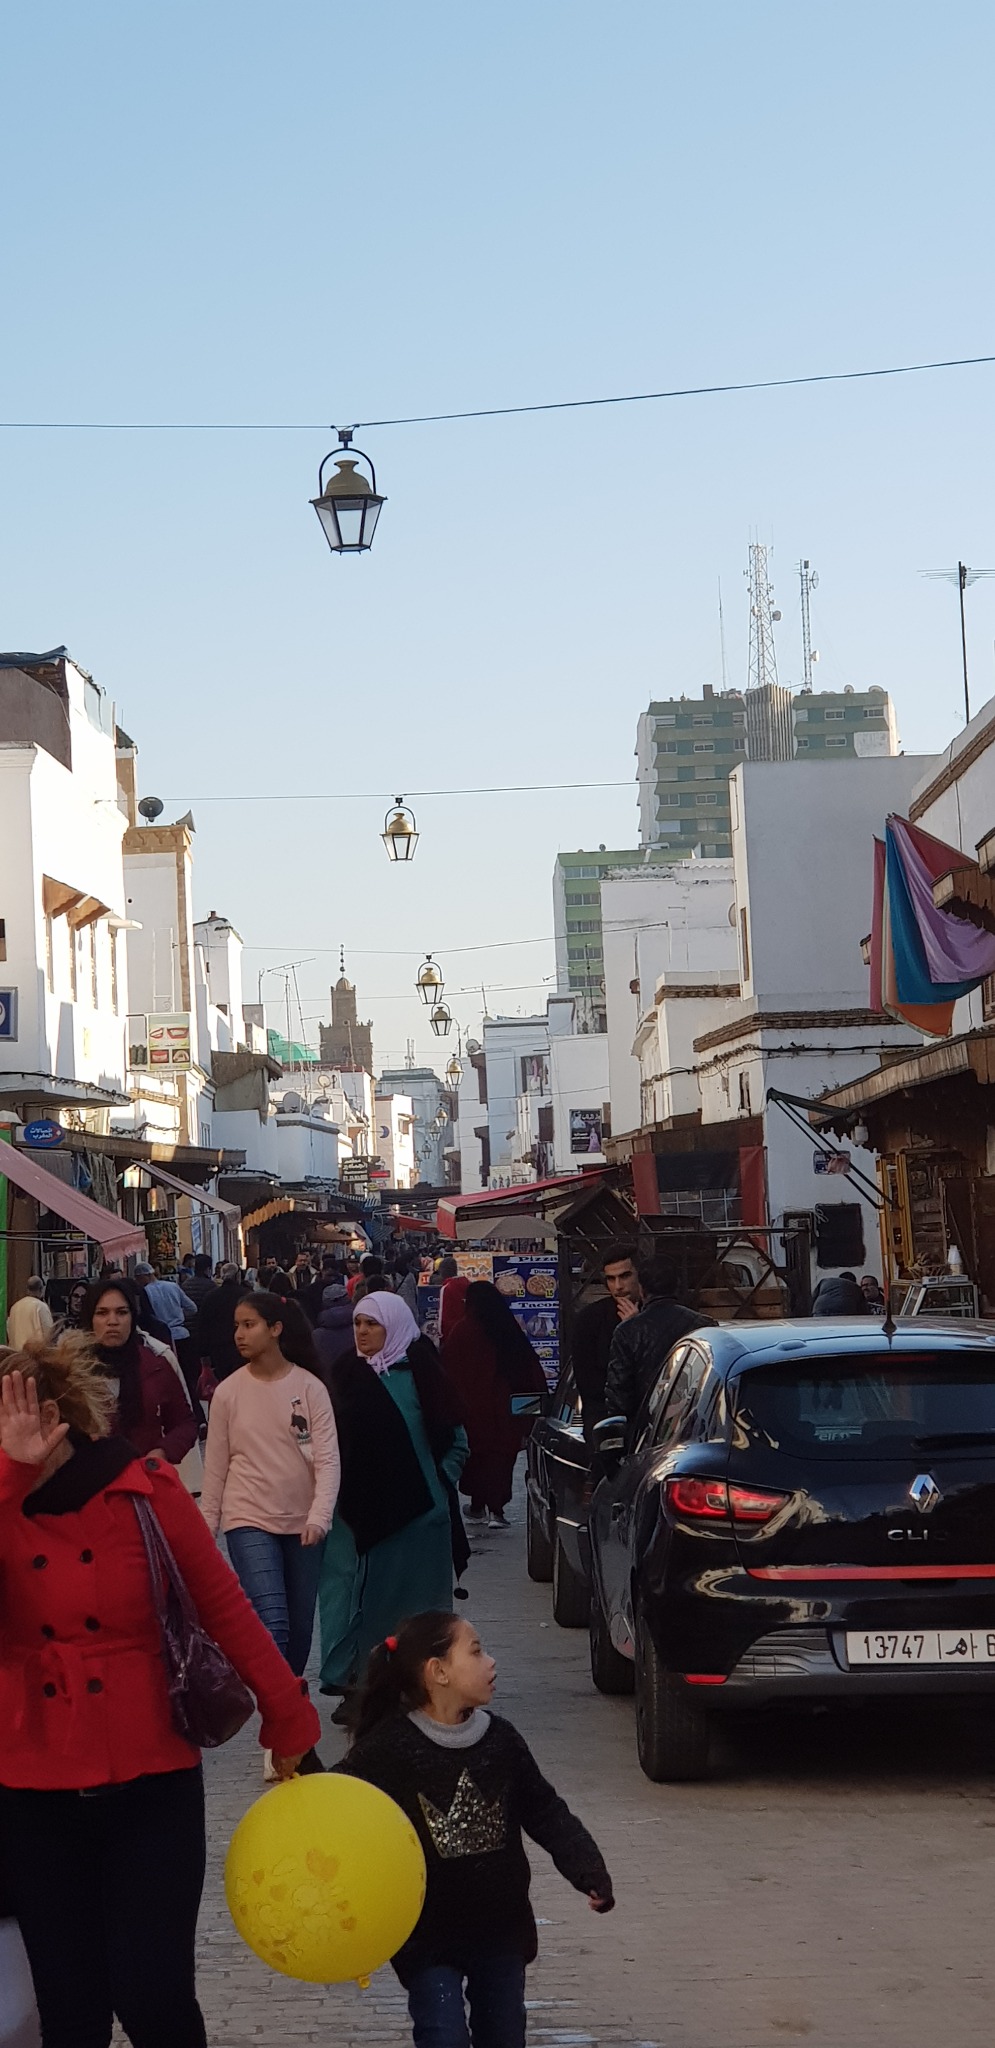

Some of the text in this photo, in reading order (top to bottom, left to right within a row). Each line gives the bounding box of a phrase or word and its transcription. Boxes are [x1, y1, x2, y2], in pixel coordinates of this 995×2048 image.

[887, 1529, 947, 1541] CLI
[864, 1635, 924, 1659] 13747
[986, 1633, 995, 1657] 6
